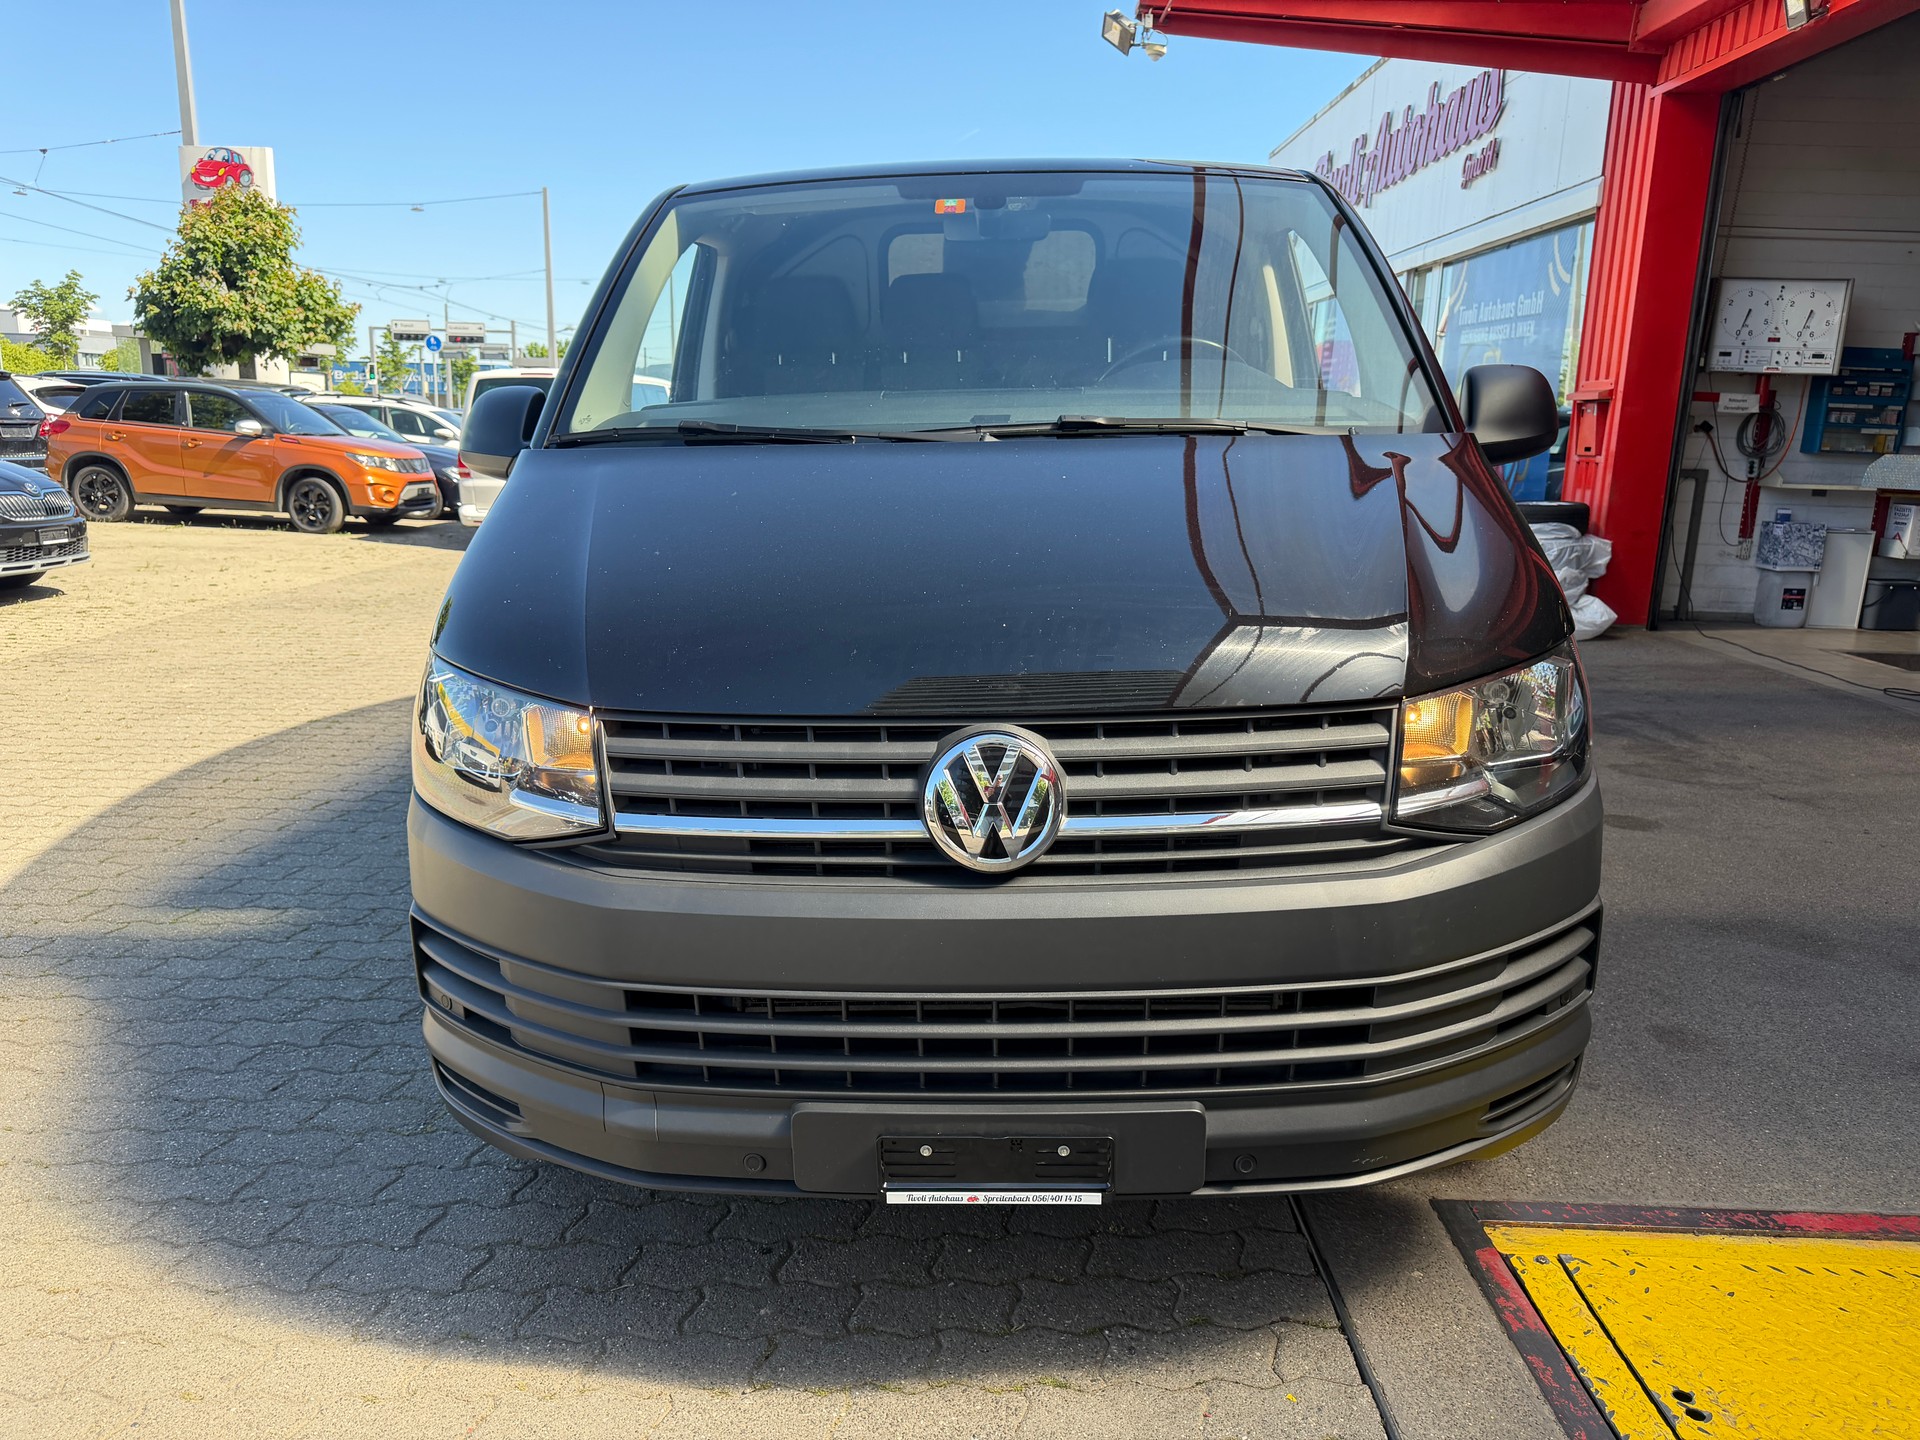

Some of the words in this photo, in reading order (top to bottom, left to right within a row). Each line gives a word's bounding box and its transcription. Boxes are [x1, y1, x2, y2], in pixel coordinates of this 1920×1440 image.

[1363, 68, 1502, 208] Autohaus
[1459, 303, 1479, 326] Tivoli
[1478, 298, 1516, 323] Autohaus
[1517, 290, 1545, 317] GmbH
[930, 736, 1057, 868] VW
[906, 1194, 926, 1202] Tivoli
[928, 1194, 963, 1202] Autohaus
[983, 1194, 1031, 1204] Spreitenbach
[1031, 1194, 1063, 1203] 056/401
[1064, 1195, 1073, 1203] 14
[1074, 1195, 1083, 1203] 15
